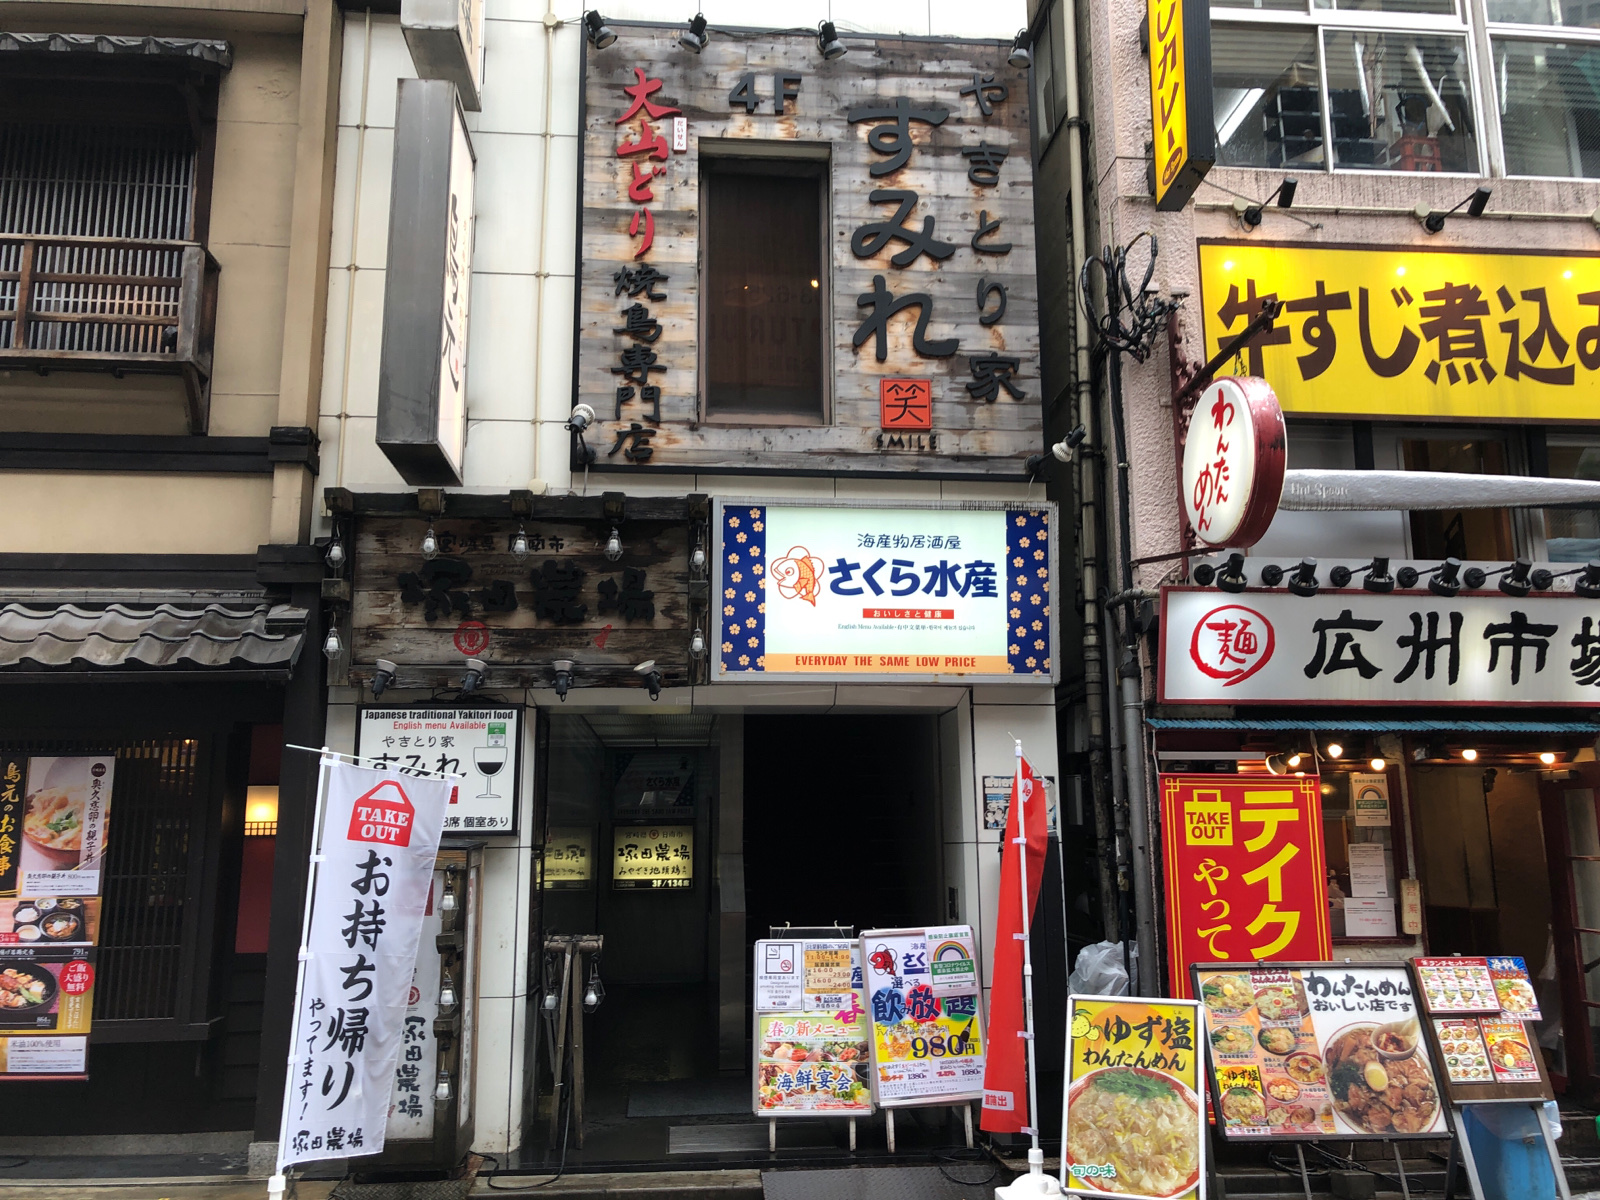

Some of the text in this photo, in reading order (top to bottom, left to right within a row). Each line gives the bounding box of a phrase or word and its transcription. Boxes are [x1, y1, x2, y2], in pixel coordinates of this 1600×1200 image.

[729, 72, 801, 114] 4F
[675, 119, 685, 148] だいせん
[615, 67, 682, 258] 大山どり
[848, 98, 960, 361] すみれ
[959, 73, 1027, 401] やきとり家
[607, 263, 669, 462] 焼鳥専門店
[875, 433, 939, 451] SMILE
[1211, 388, 1235, 506] わんたん
[1193, 464, 1214, 532] めん
[857, 533, 961, 550] 海産物居酒屋
[829, 558, 998, 598] さくら水産
[873, 609, 942, 619] おいしさと健康
[795, 655, 976, 668] EVERYDAY THE SAME LOW PRICE
[365, 710, 514, 720] Japanese traditional Yakitori food
[393, 721, 422, 731] English
[449, 721, 486, 730] Available
[382, 735, 455, 748] やきとり家
[357, 807, 410, 827] TAKE
[464, 816, 509, 828] 個室あり
[1186, 811, 1230, 825] TAKE
[361, 825, 400, 841] OUT
[1191, 825, 1227, 840] OUT
[618, 843, 690, 862] 塚田農場
[1239, 789, 1301, 961] テイク
[1193, 858, 1231, 961] やって
[68, 963, 86, 973] ご飯
[64, 973, 89, 983] 大盛り
[66, 982, 85, 992] 無料
[321, 849, 393, 1111] お持ち帰り
[891, 976, 920, 989] 選べる
[1303, 971, 1412, 997] わんたんめん
[1313, 999, 1412, 1013] おいしい店です
[769, 1020, 860, 1038] 春の新メニュー
[1104, 1014, 1194, 1052] ゆず塩
[911, 1034, 975, 1058] 980円
[397, 1016, 426, 1119] 塚田農場
[1082, 1047, 1187, 1072] わんたんめん
[776, 1069, 853, 1092] 海鮮宴会
[1227, 1068, 1260, 1083] ゆず塩
[293, 1127, 364, 1155] 塚田農場
[1070, 1163, 1117, 1178] 旬の味
